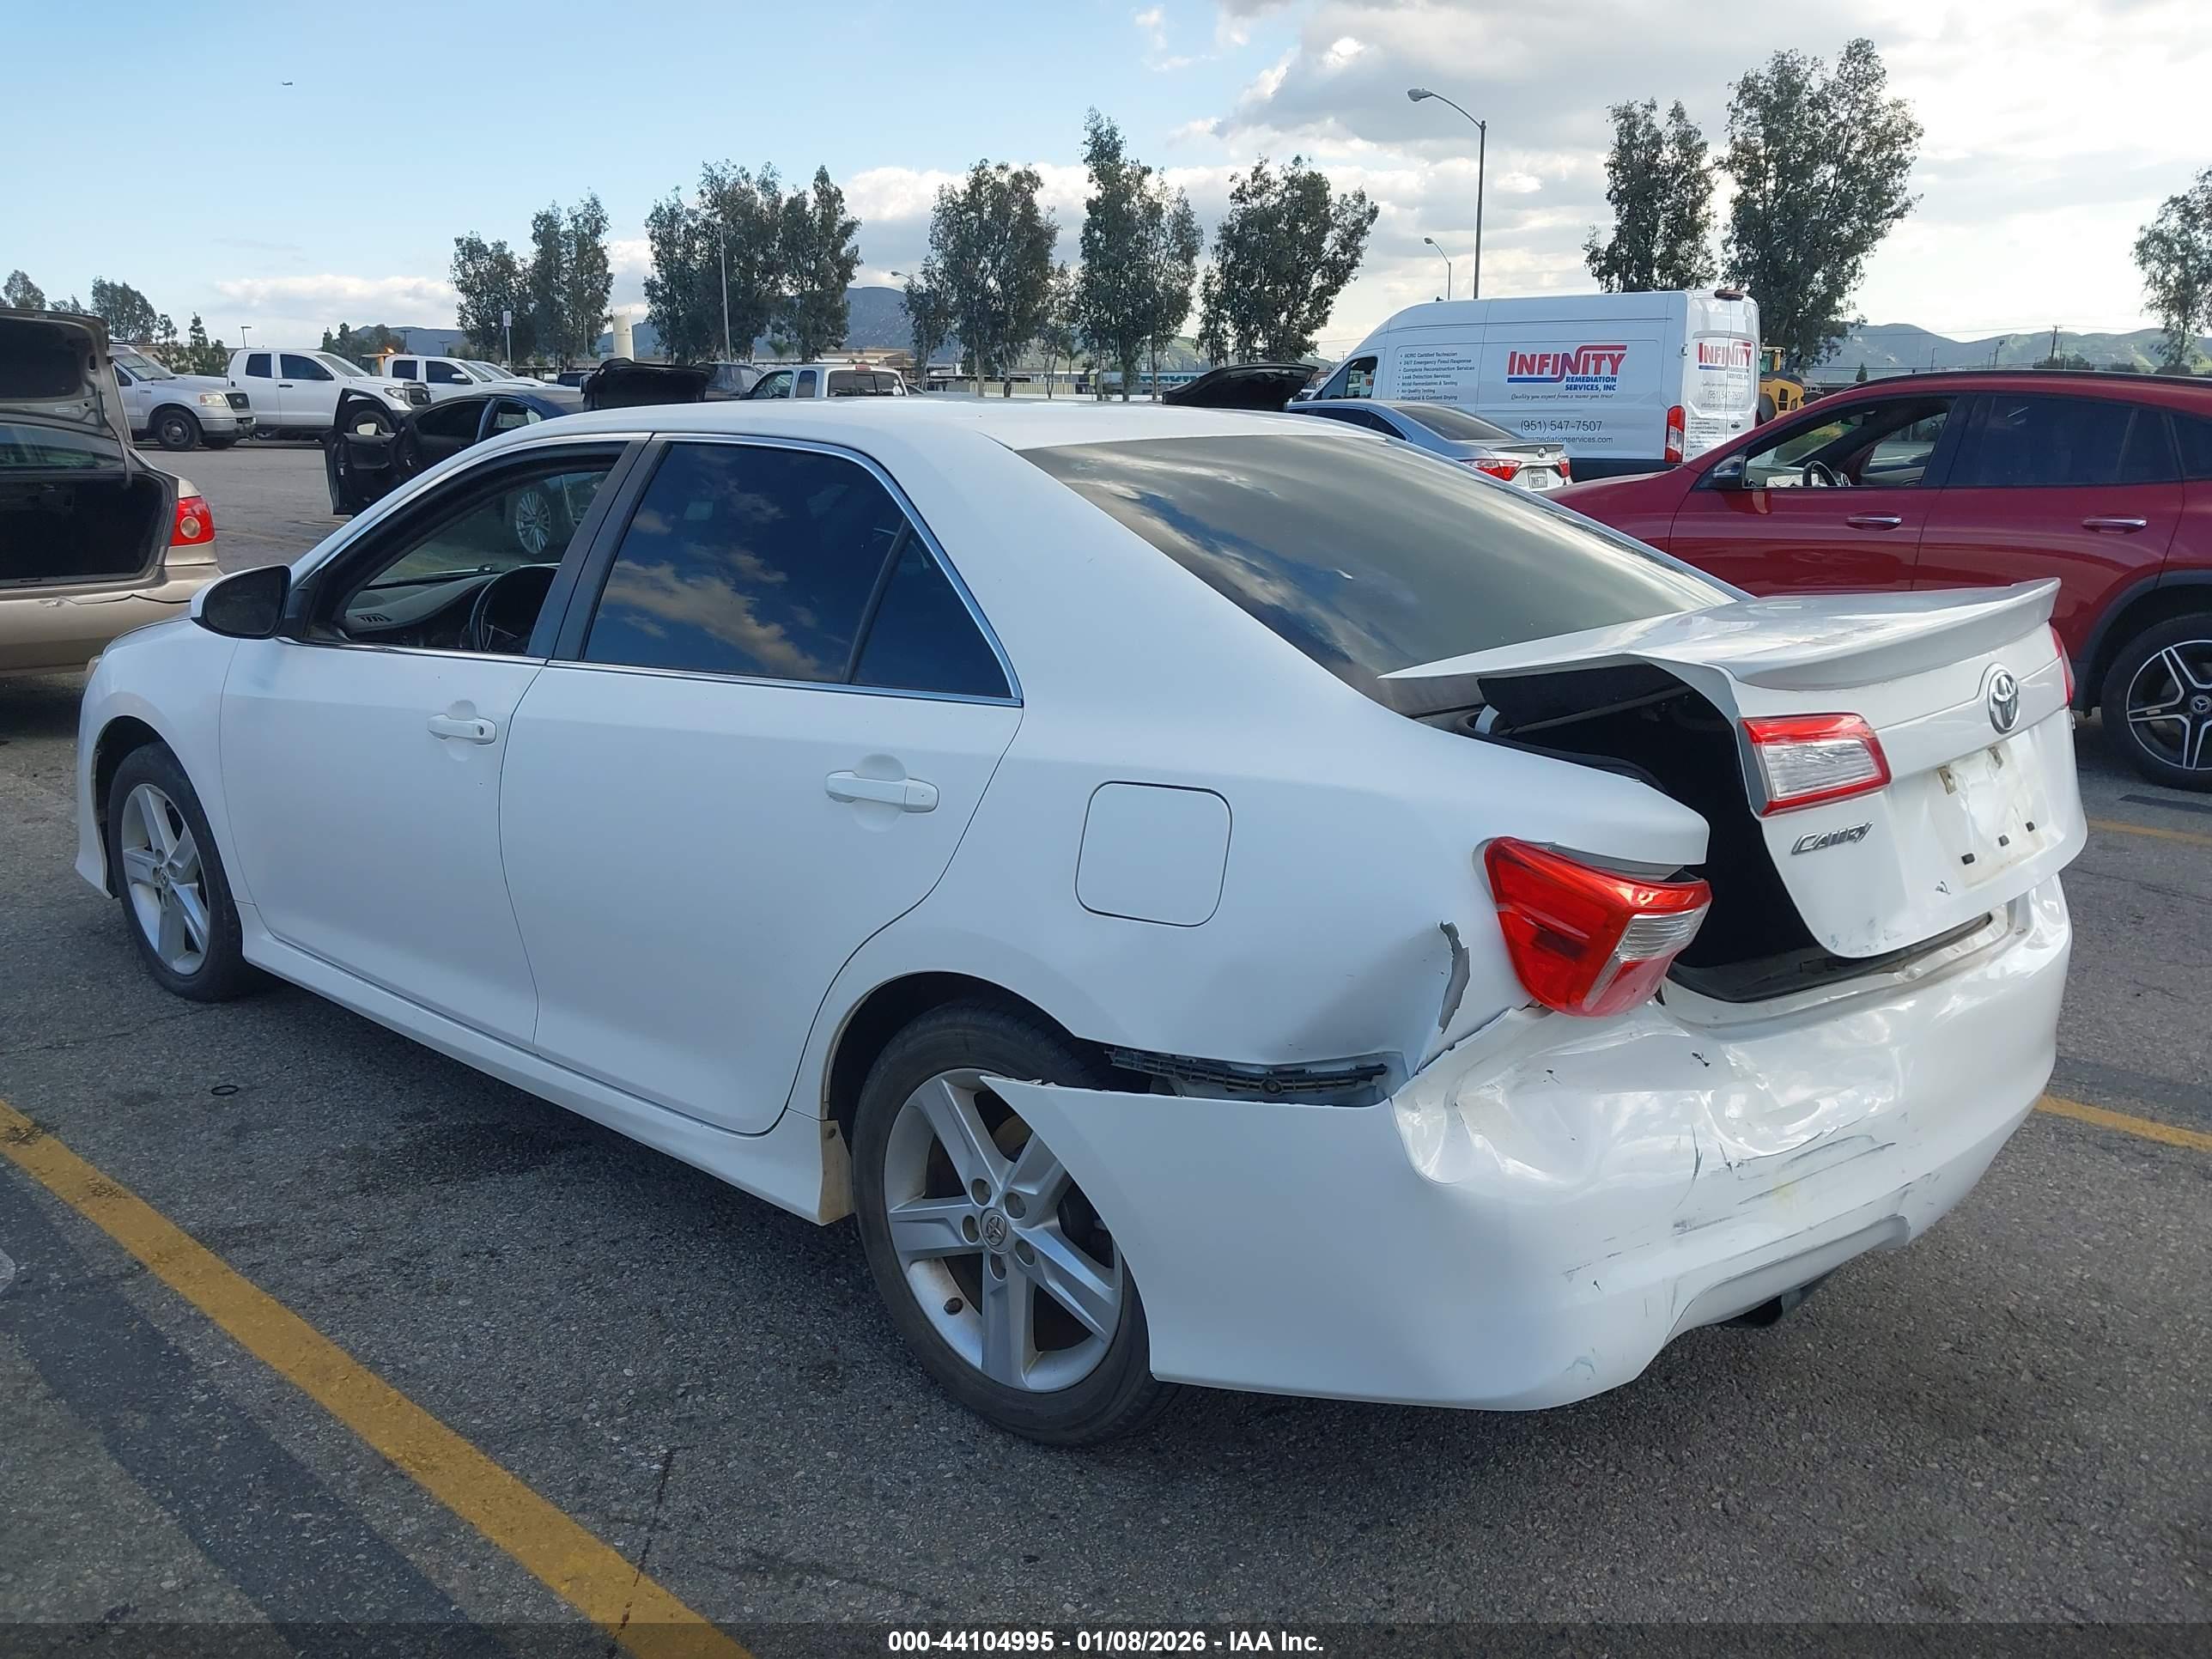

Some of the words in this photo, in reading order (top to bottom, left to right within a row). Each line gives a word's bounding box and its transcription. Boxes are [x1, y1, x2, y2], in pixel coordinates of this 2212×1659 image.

[1507, 347, 1627, 377] INFINITY
[1698, 342, 1752, 367] INFINITY
[1565, 384, 1601, 392] SERVICES,
[1520, 419, 1547, 433] (951)
[1550, 420, 1602, 431] 547-7507
[1791, 821, 1874, 855] CAMRY
